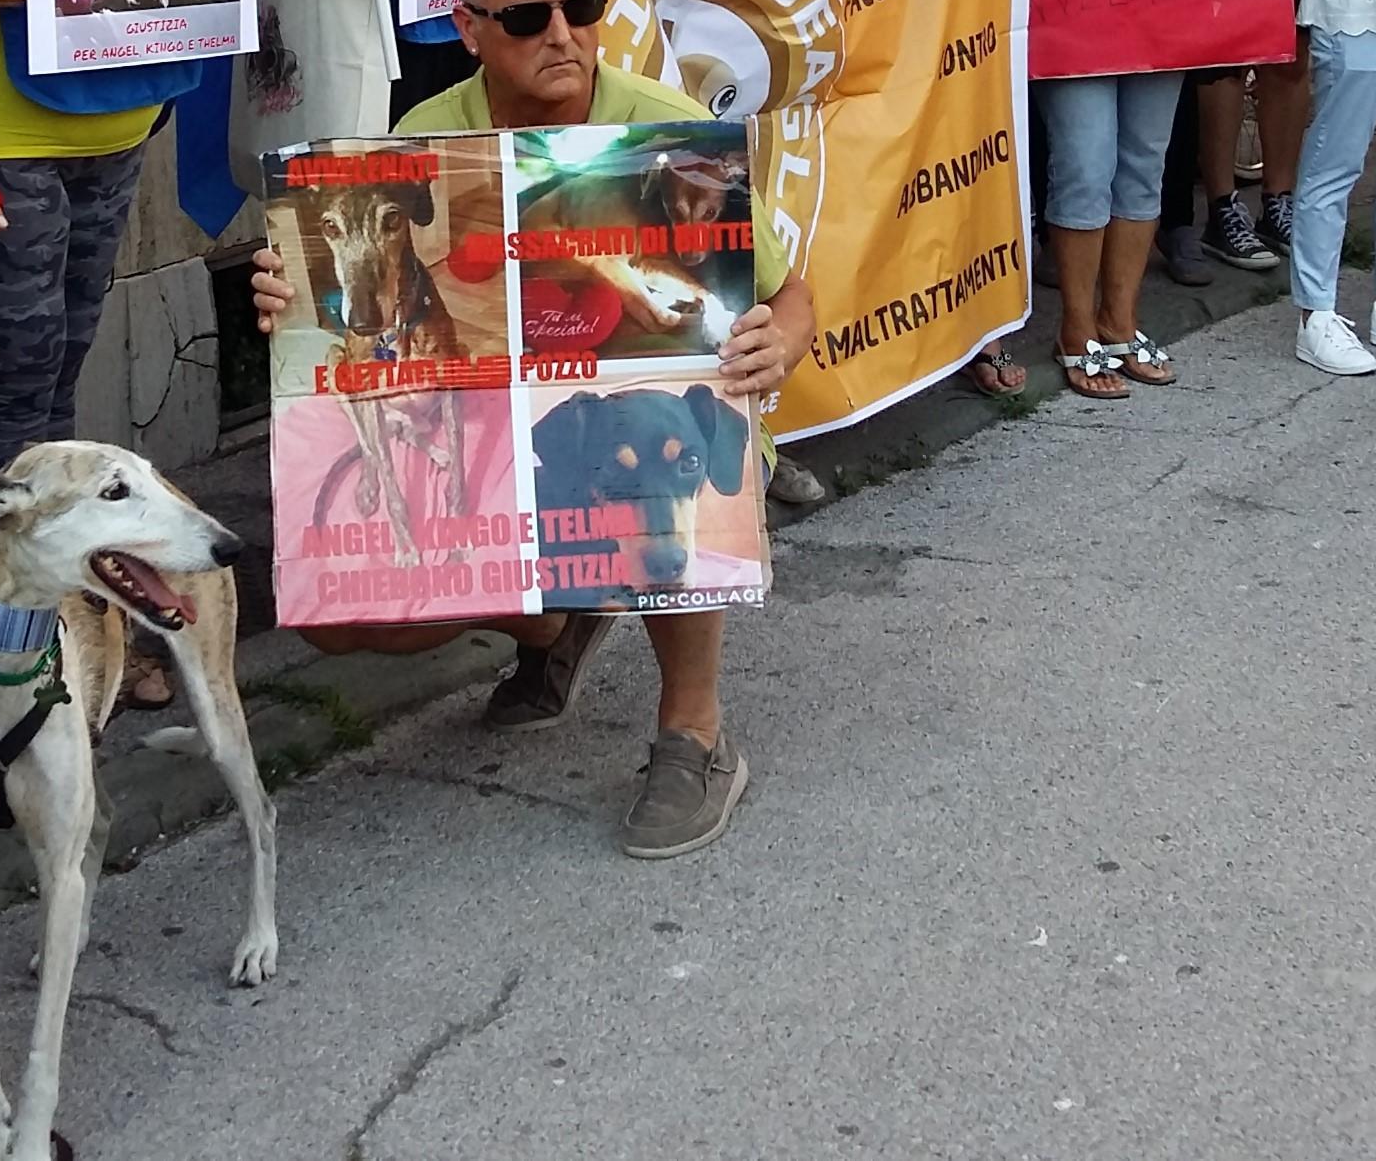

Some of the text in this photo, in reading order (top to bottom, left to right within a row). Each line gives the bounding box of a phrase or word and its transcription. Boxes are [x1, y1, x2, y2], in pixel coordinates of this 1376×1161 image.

[126, 18, 188, 35] GIUSTIZIA
[73, 49, 97, 62] PER
[188, 39, 195, 51] E
[197, 35, 236, 49] THELMA
[286, 153, 440, 188] AVVELENATI
[639, 223, 669, 255] DI
[314, 364, 330, 394] E
[519, 350, 599, 382] POZZO
[518, 511, 535, 544] E
[538, 503, 639, 544] TELMA
[480, 551, 628, 599] GIUSTIZIA
